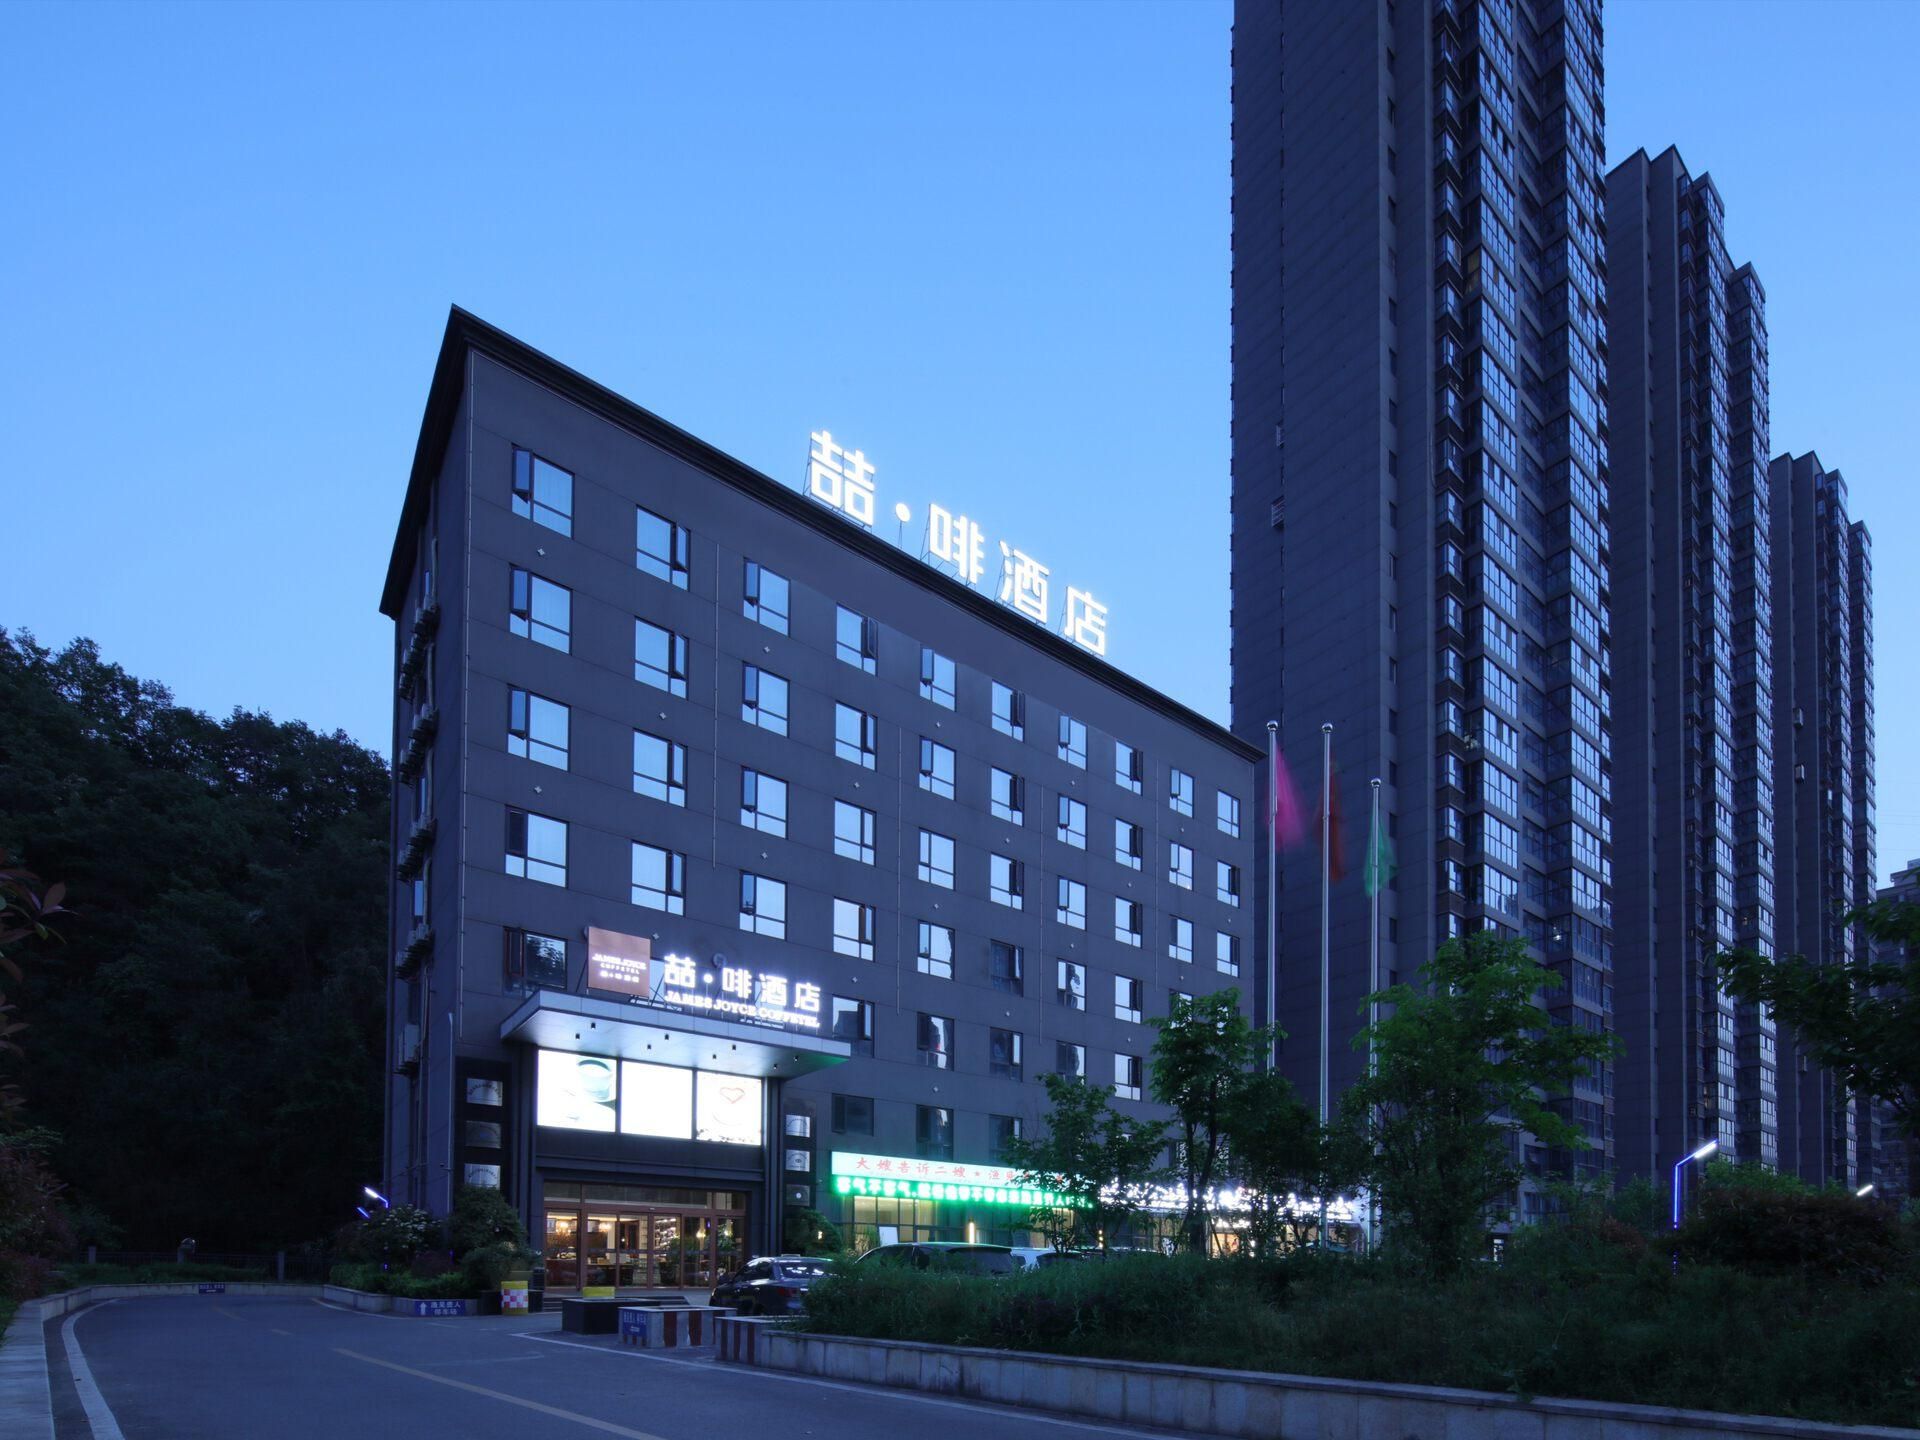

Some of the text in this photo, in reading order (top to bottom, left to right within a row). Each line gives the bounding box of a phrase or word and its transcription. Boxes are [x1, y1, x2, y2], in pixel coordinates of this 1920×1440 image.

[809, 430, 1108, 656] 喆·啡酒店
[664, 952, 821, 1012] 喆·啡酒店
[664, 990, 712, 1009] JAMES
[713, 998, 757, 1016] JOYCE
